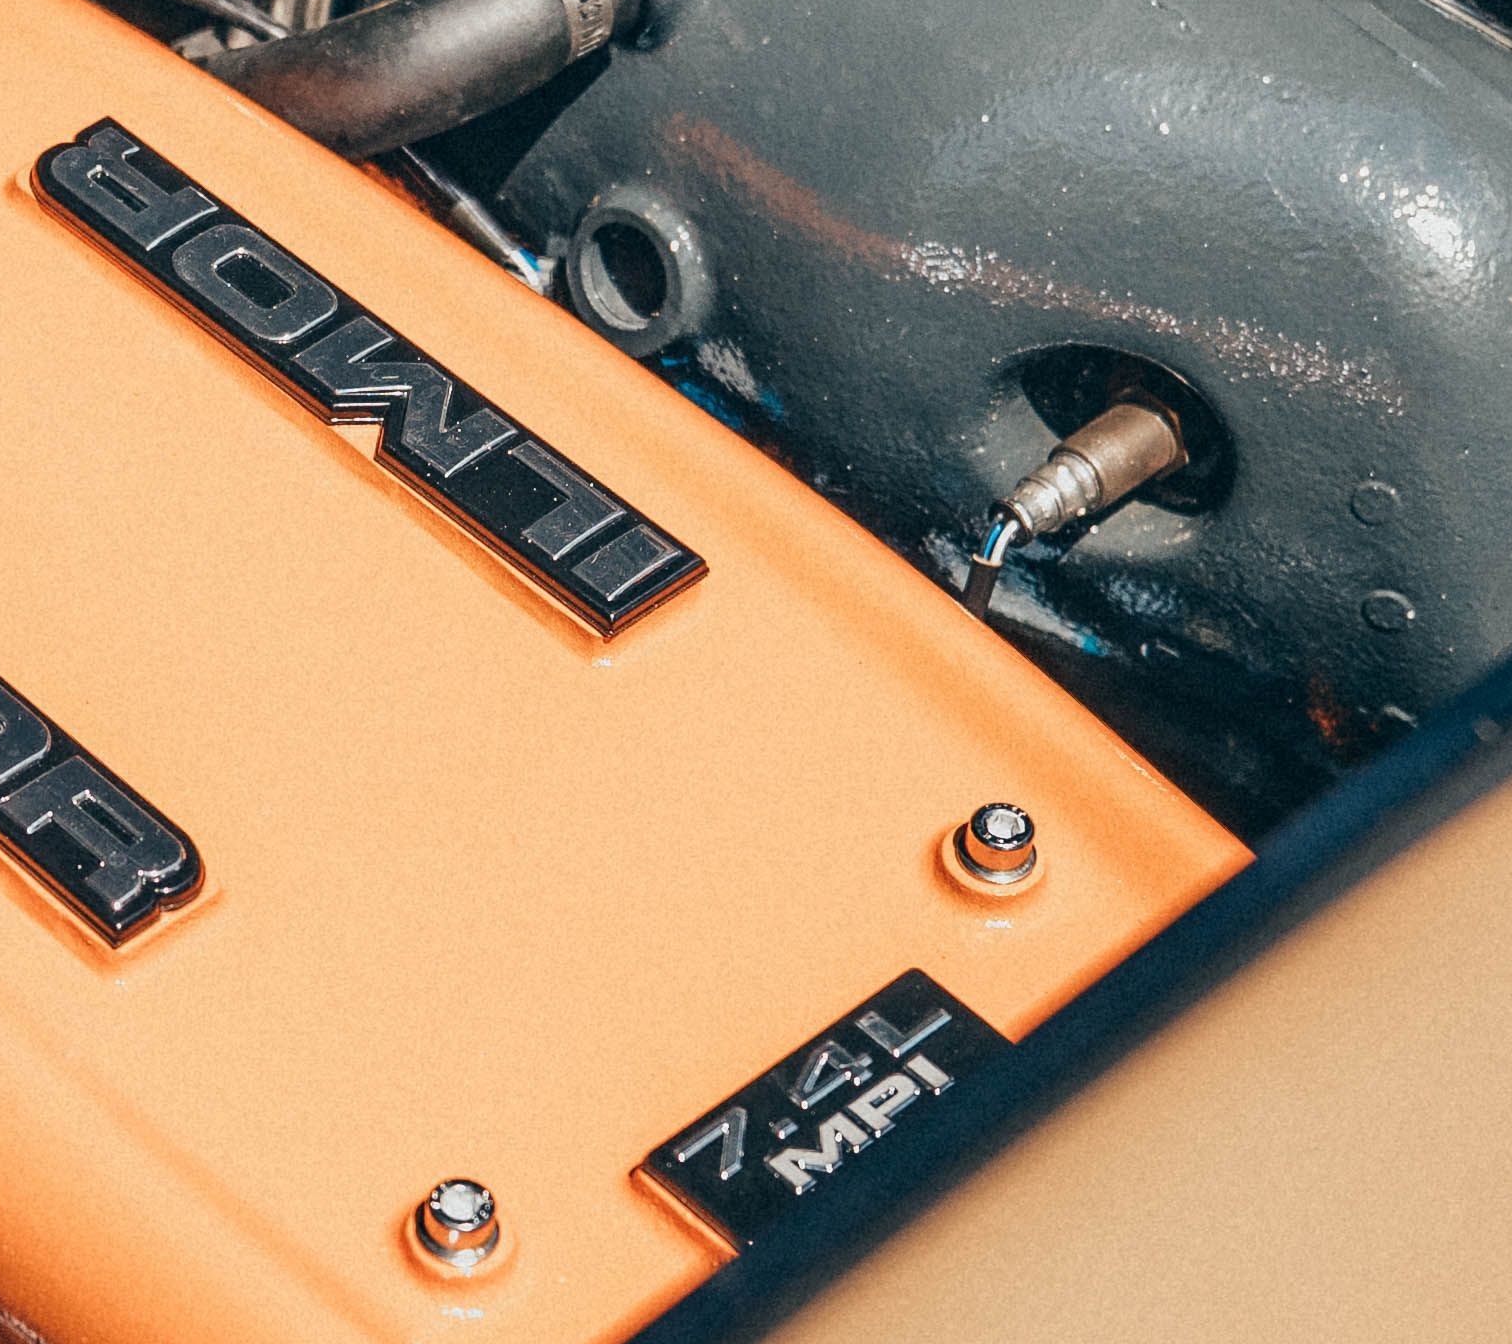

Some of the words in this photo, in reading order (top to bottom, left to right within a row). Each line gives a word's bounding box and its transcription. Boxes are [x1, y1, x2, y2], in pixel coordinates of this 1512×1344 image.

[50, 126, 682, 602] ILMOR
[673, 1007, 953, 1180] 7.4L
[765, 1053, 956, 1195] MPI
